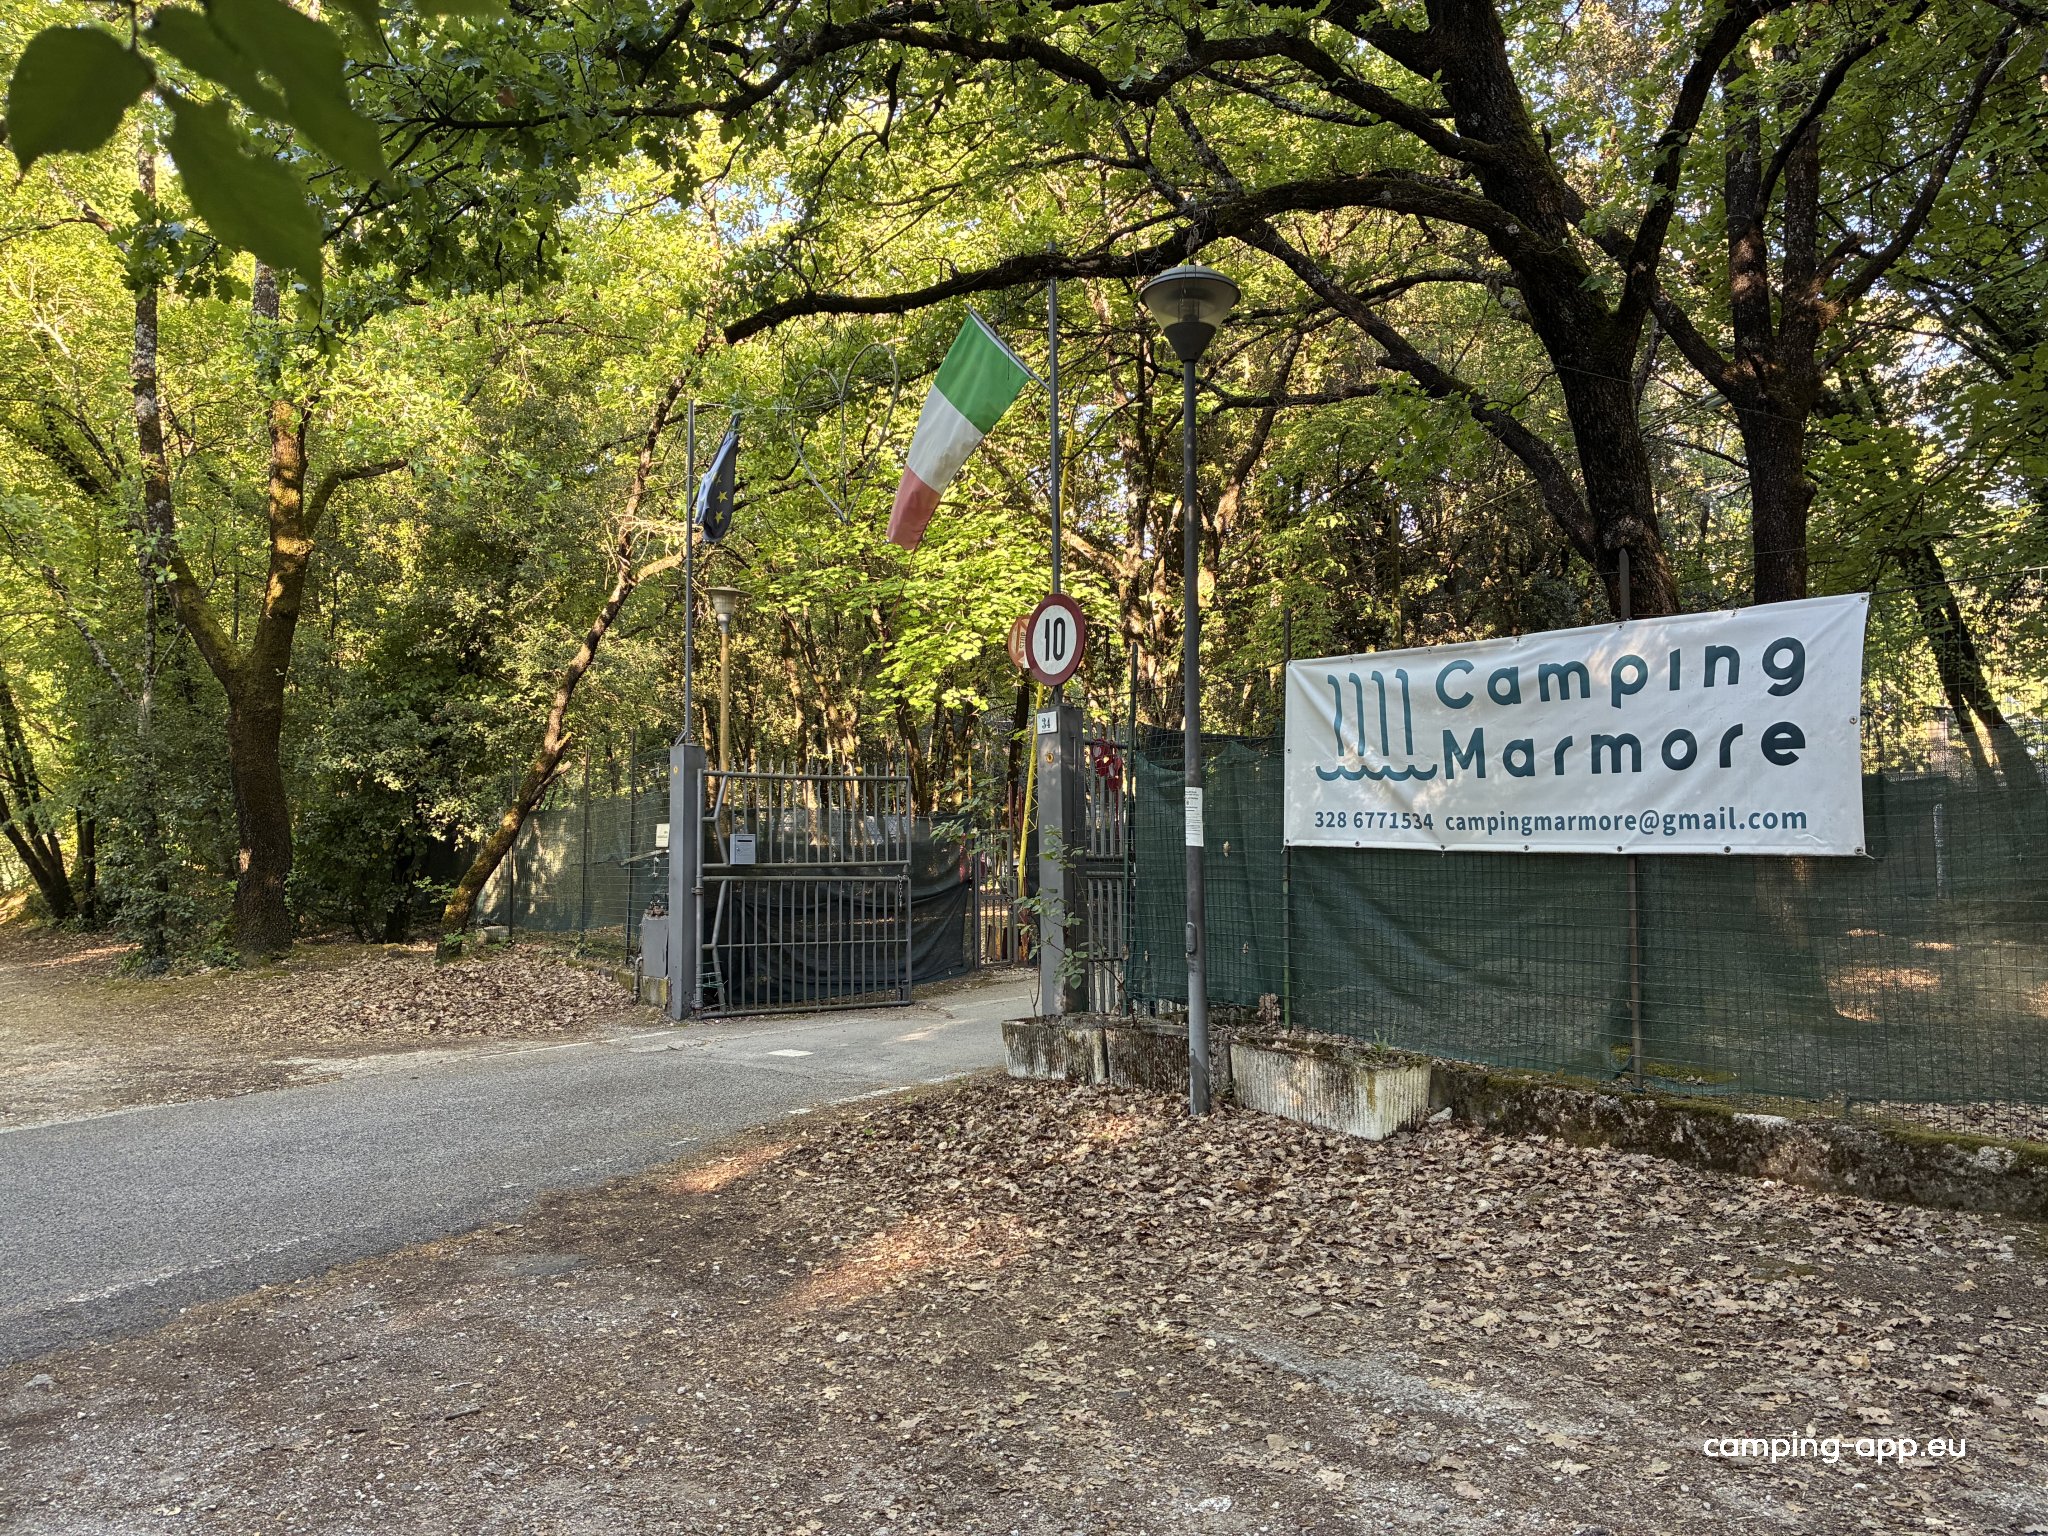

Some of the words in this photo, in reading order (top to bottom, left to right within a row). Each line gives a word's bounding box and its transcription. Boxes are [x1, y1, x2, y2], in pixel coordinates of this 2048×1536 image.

[1045, 617, 1066, 661] 10
[1435, 637, 1806, 709] Camping
[1041, 717, 1051, 730] 34
[1443, 722, 1807, 779] Marmore
[1315, 811, 1347, 828] 328
[1353, 811, 1434, 830] 6771534
[1445, 806, 1807, 836] campingmarmore@gmail.com
